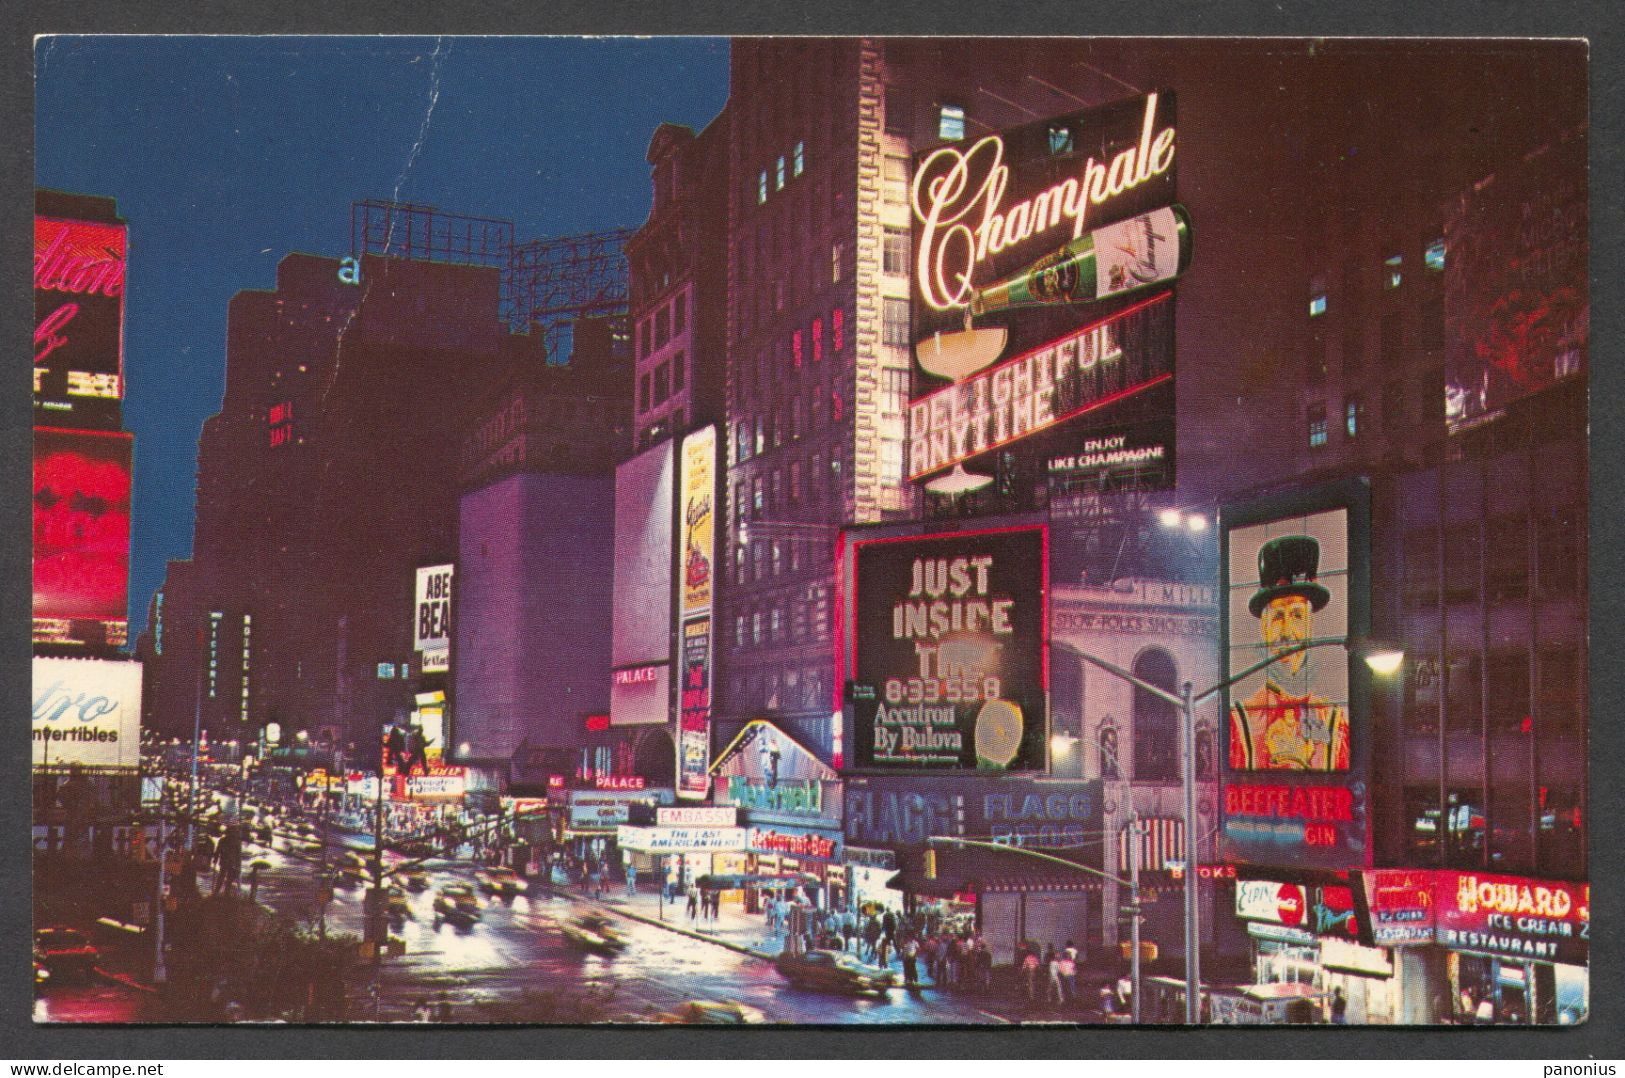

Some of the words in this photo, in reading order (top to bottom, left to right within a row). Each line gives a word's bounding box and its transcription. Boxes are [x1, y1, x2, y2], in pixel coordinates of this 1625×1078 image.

[911, 92, 1175, 312] Champale
[910, 324, 1122, 441] DELIGHTFUL
[910, 385, 1055, 477] ANYTIME
[1084, 436, 1126, 451] ENJOY
[1048, 457, 1075, 472] LIKE
[1078, 446, 1165, 468] CHAMPAGNE
[909, 556, 993, 597] JUST
[893, 600, 1015, 638] INSIDE
[616, 667, 656, 685] PALACE
[874, 701, 957, 725] Accutron
[874, 724, 900, 755] By
[902, 724, 963, 752] Bulova
[596, 777, 644, 788] PALACE
[984, 794, 1092, 820] FLAGG
[1225, 785, 1353, 820] BEEFEATER
[660, 809, 734, 825] EMBASSY
[1305, 826, 1336, 846] GIN
[1457, 874, 1572, 918] HOWARD
[1486, 913, 1513, 929] ICE
[1448, 929, 1558, 956] RESTAURANT
